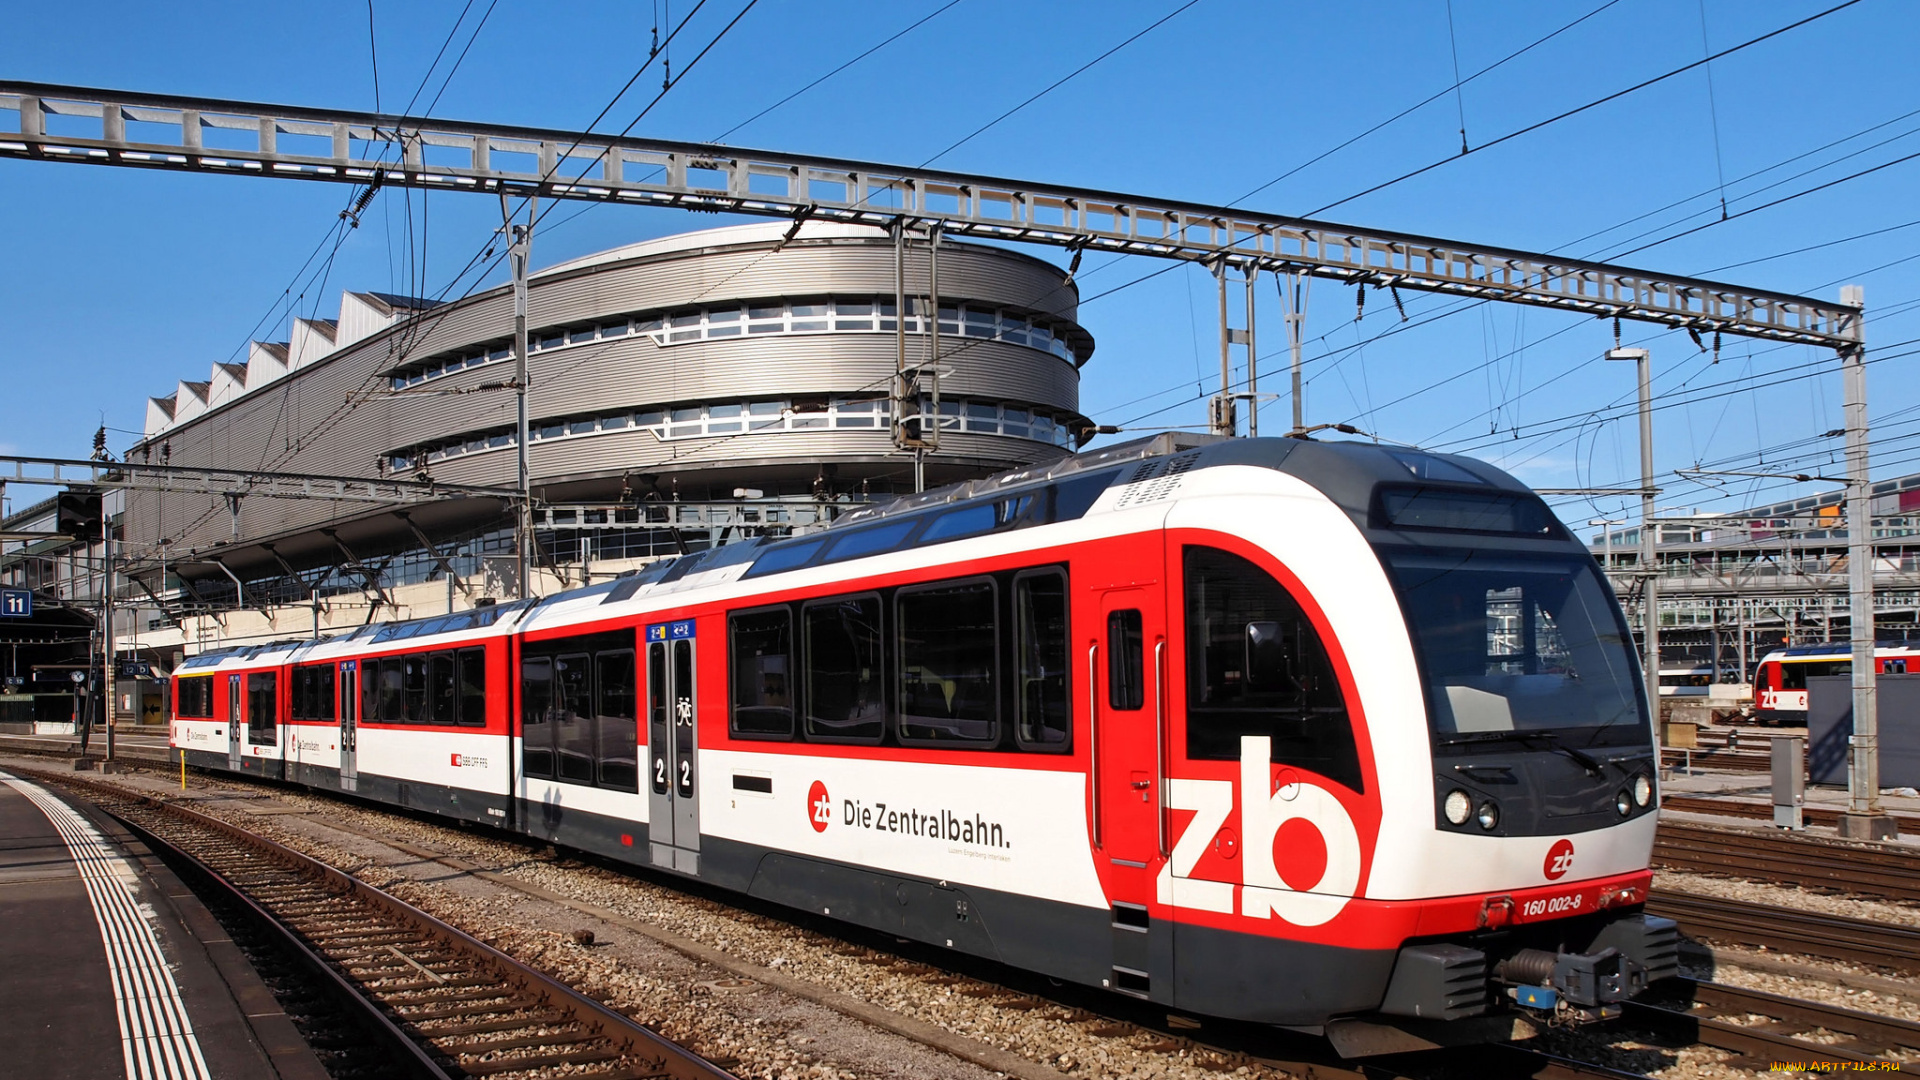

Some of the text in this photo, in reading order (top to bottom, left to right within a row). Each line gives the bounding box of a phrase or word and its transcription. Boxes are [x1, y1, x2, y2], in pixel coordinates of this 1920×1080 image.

[8, 597, 23, 612] 11
[1762, 686, 1778, 708] zb
[343, 731, 347, 745] 2
[351, 732, 355, 746] 2
[656, 758, 664, 783] 2
[681, 760, 690, 786] 2
[813, 794, 830, 823] zb
[844, 798, 1010, 848] Die Zentralbahn.
[1157, 735, 1361, 926] zb
[1551, 850, 1574, 872] zb
[1523, 894, 1582, 916] 160 002-8
